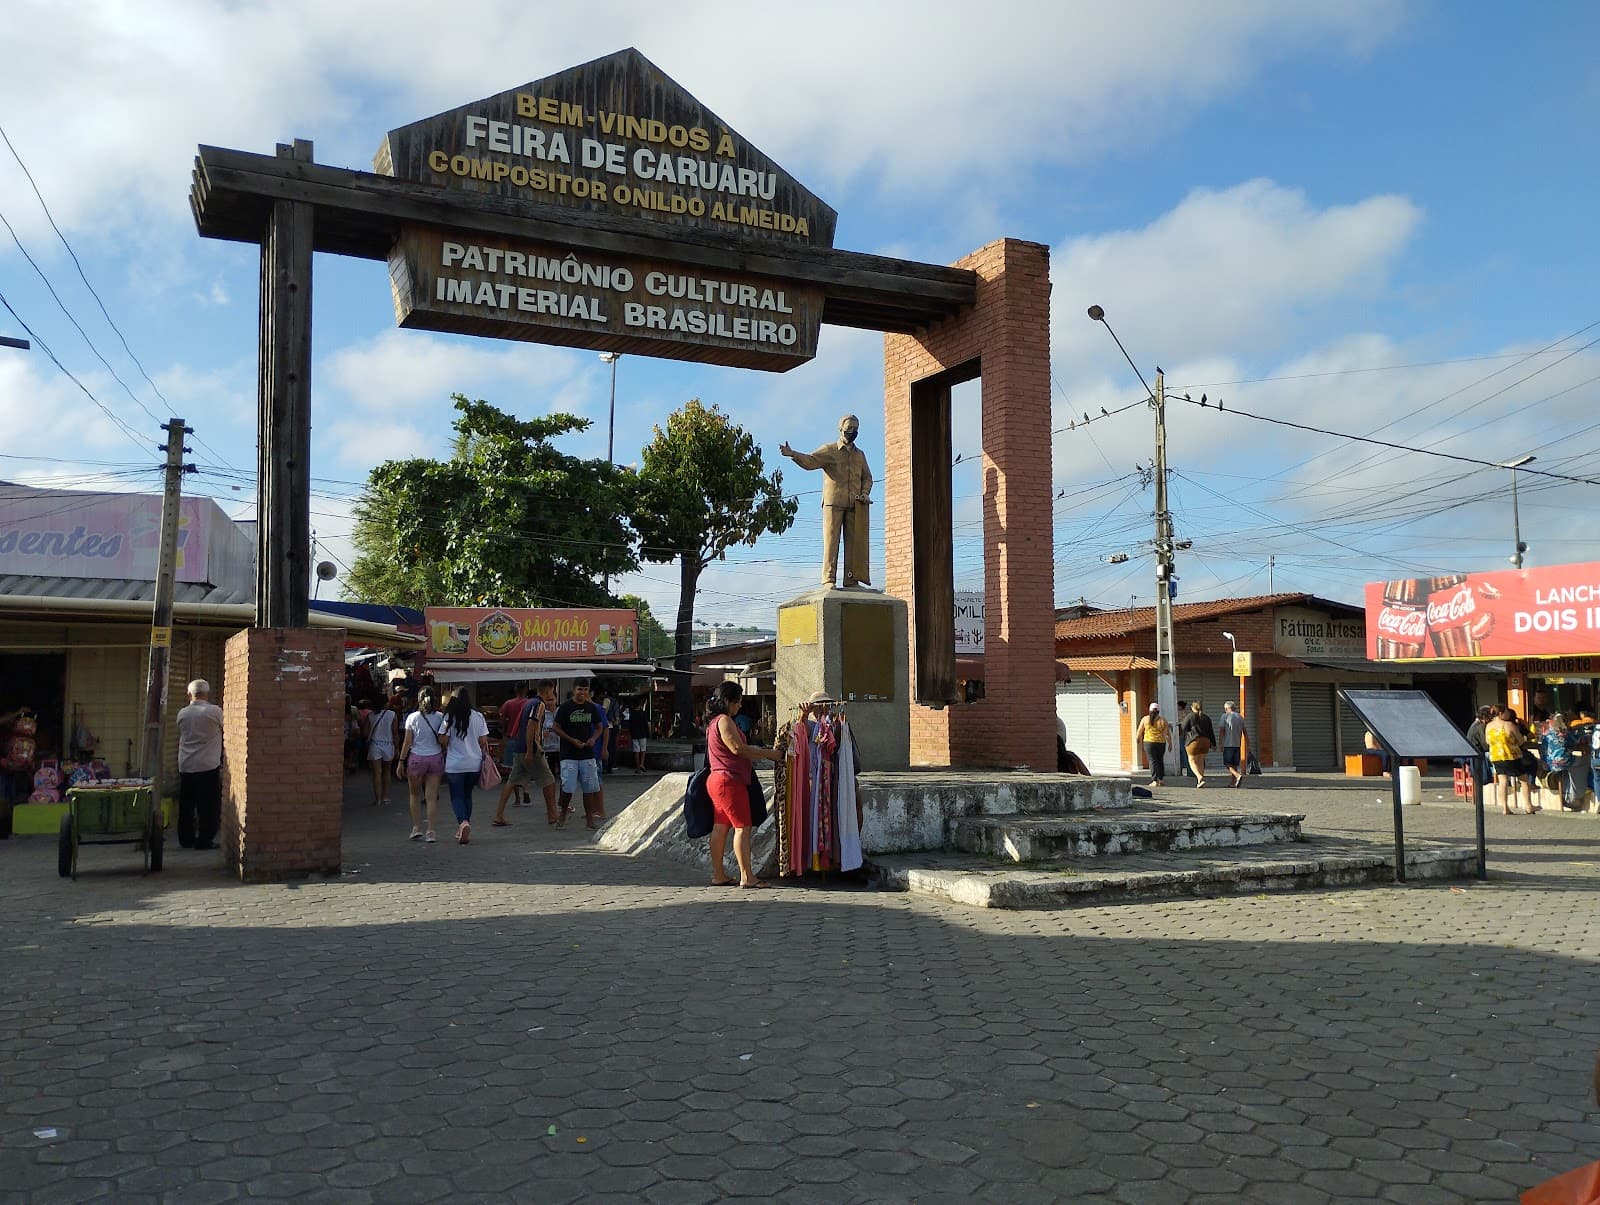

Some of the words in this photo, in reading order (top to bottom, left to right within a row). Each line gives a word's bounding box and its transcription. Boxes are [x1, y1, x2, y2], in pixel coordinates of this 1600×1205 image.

[516, 93, 710, 152] BEM-VINDOS
[715, 126, 736, 158] À
[466, 115, 570, 164] FEIRA
[581, 138, 627, 175] DE
[633, 148, 777, 200] CARUARU
[428, 150, 608, 202] COMPOSITOR
[613, 184, 706, 217] ONILDO
[711, 201, 809, 237] ALMEIDA
[442, 241, 634, 292] PATRIMÔNIO
[645, 271, 793, 314] CULTURAL
[436, 277, 607, 323] IMATERIAL
[624, 302, 797, 346] BRASILEIRO
[1535, 585, 1600, 605] LANCH
[523, 616, 551, 638] SÃO
[553, 616, 589, 640] JOÃO
[1280, 619, 1323, 637] Fátima
[1515, 609, 1578, 633] DOIS
[524, 640, 588, 652] LANCHONETE
